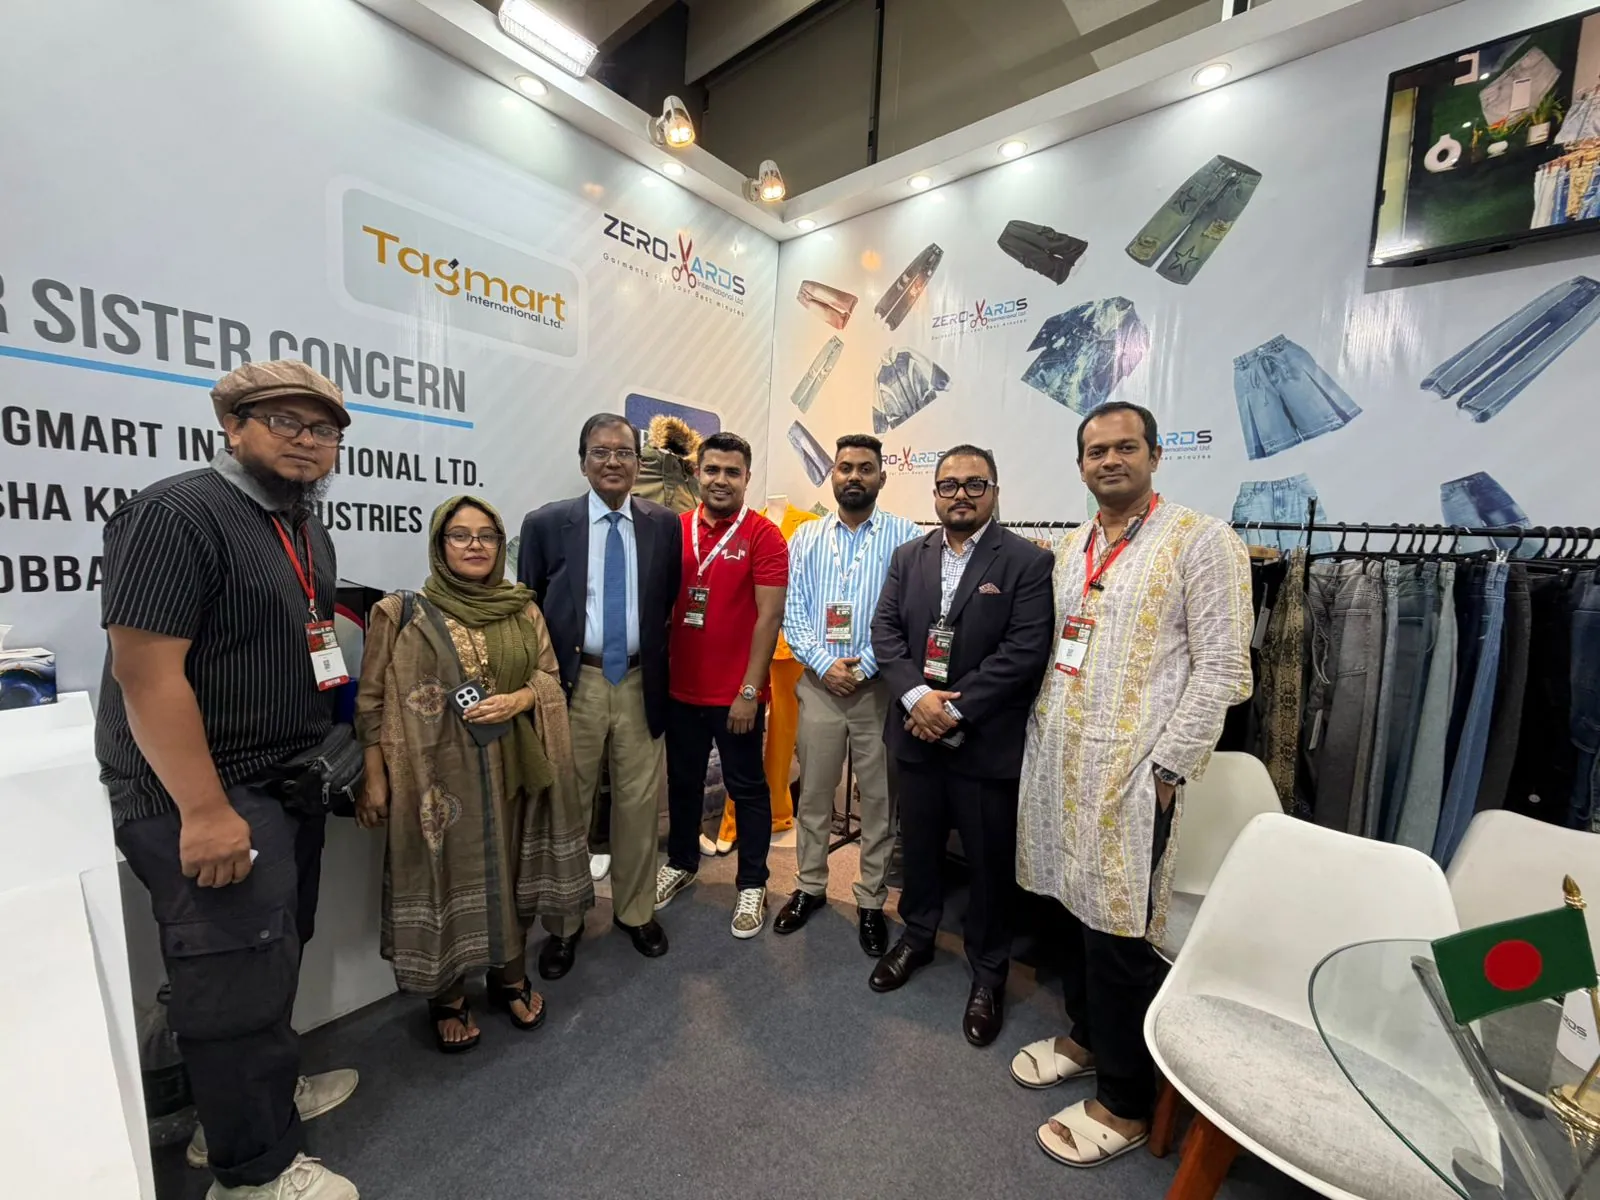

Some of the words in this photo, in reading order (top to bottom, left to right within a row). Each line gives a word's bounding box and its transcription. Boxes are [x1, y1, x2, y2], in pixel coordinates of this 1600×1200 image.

[362, 225, 566, 321] Tagmart
[466, 292, 541, 323] International
[542, 315, 564, 330] Ltd.
[32, 278, 252, 372] SISTER
[269, 329, 466, 413] CONCERN
[177, 425, 427, 483] INTTIONAL
[435, 456, 484, 488] LTD.
[0, 481, 72, 522] HA
[313, 501, 423, 534] USTRIES
